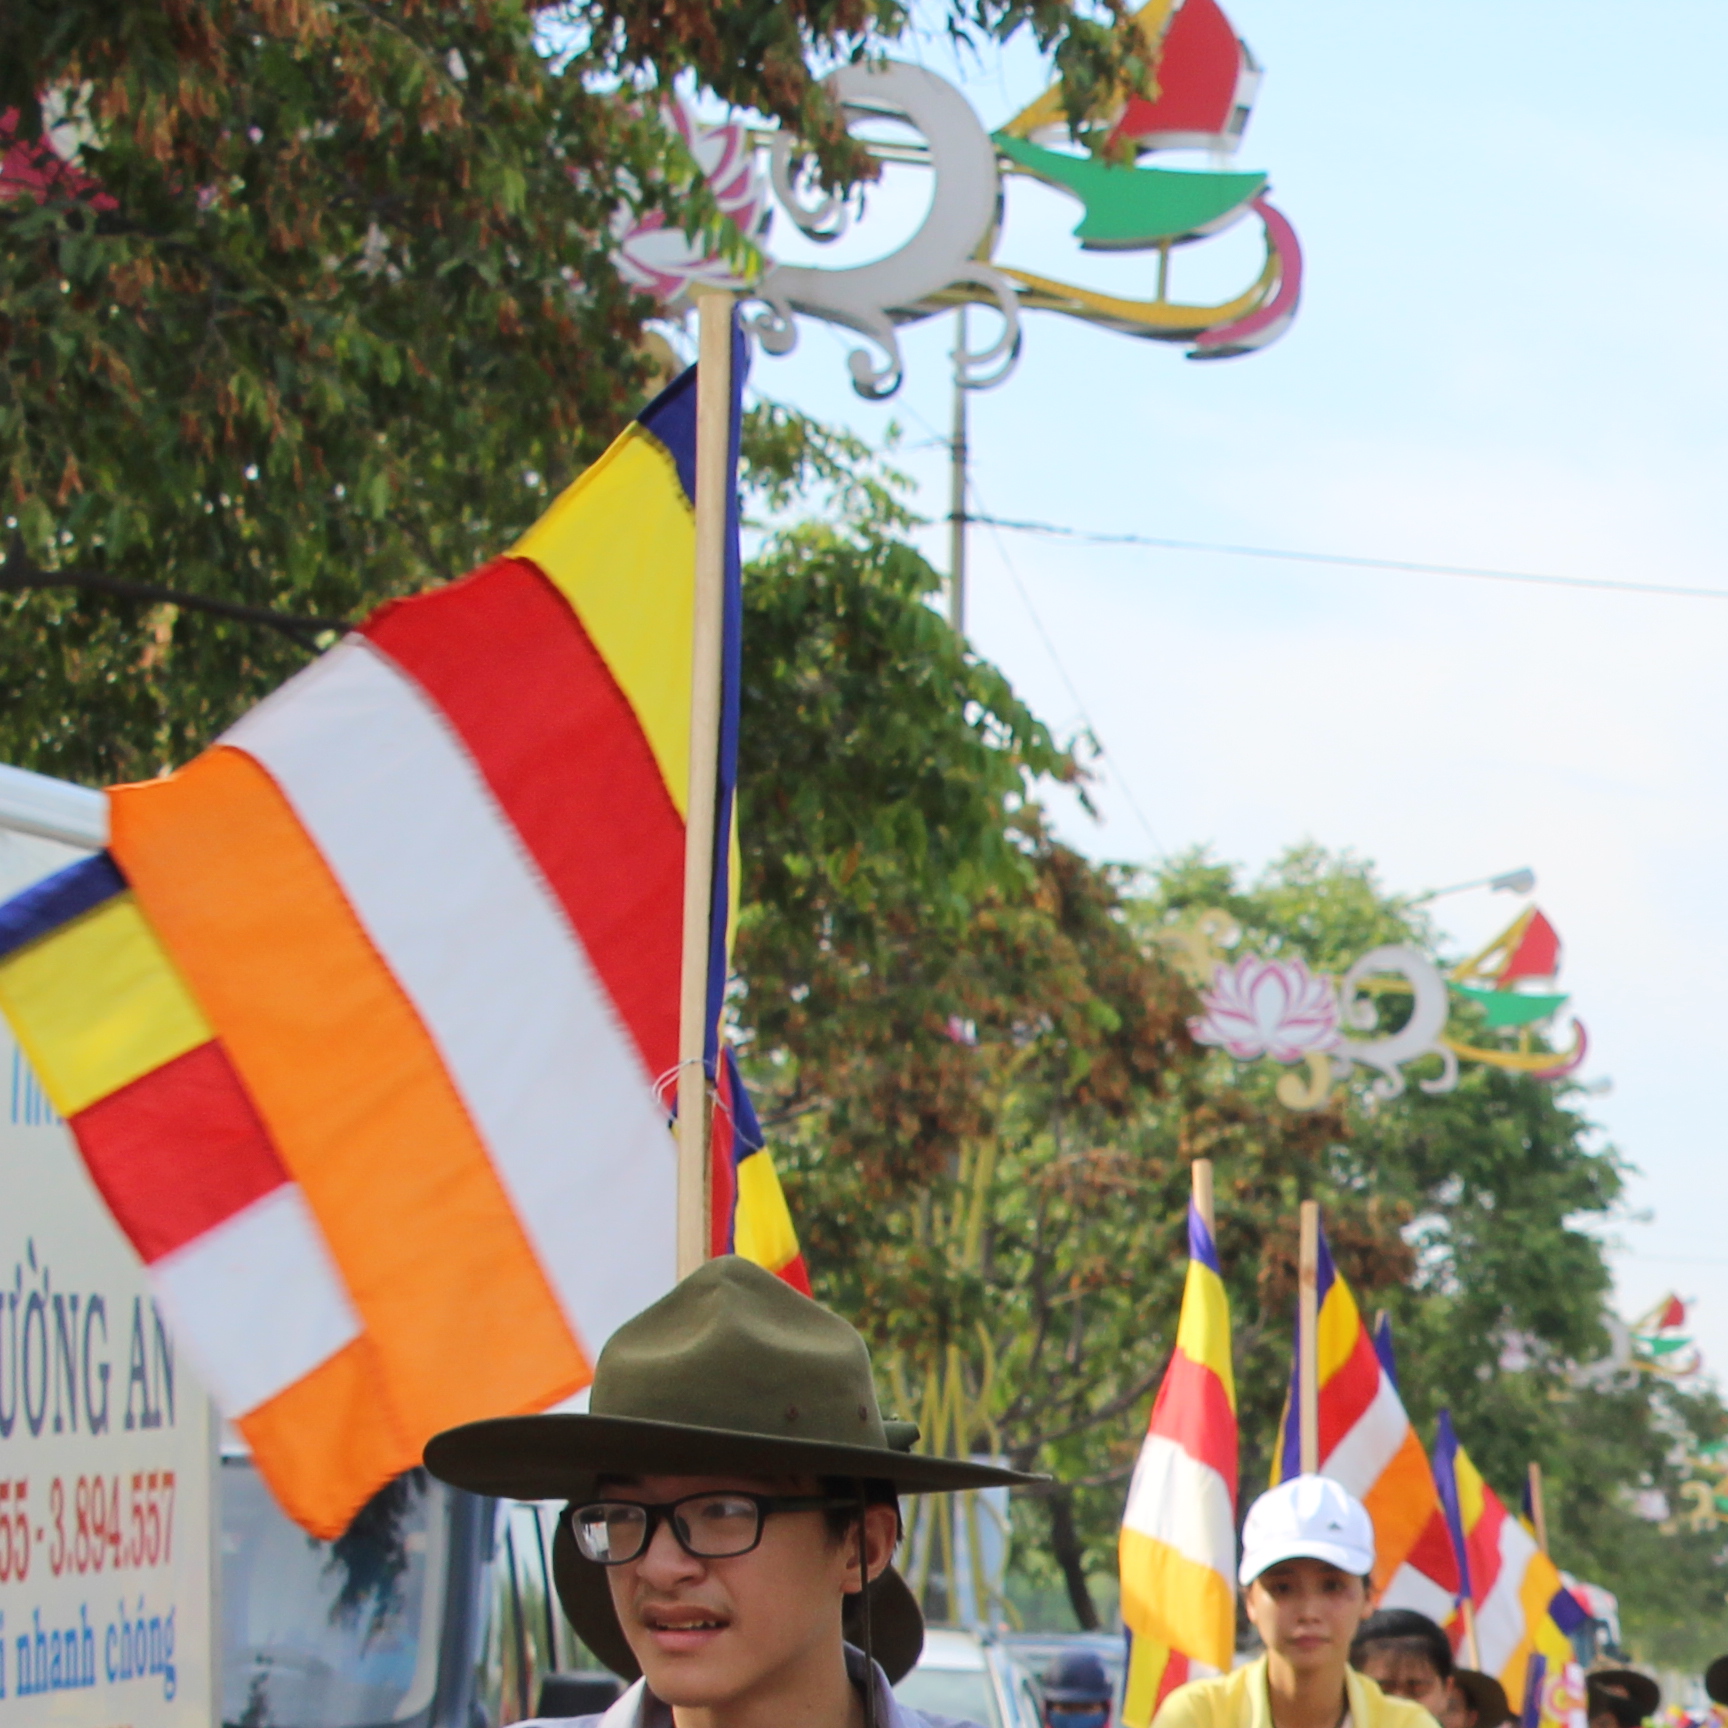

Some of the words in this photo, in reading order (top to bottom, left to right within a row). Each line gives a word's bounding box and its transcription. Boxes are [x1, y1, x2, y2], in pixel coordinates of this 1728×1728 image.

[123, 1295, 176, 1432] AN
[15, 1602, 96, 1698] nhanh
[104, 1592, 177, 1703] chóng
